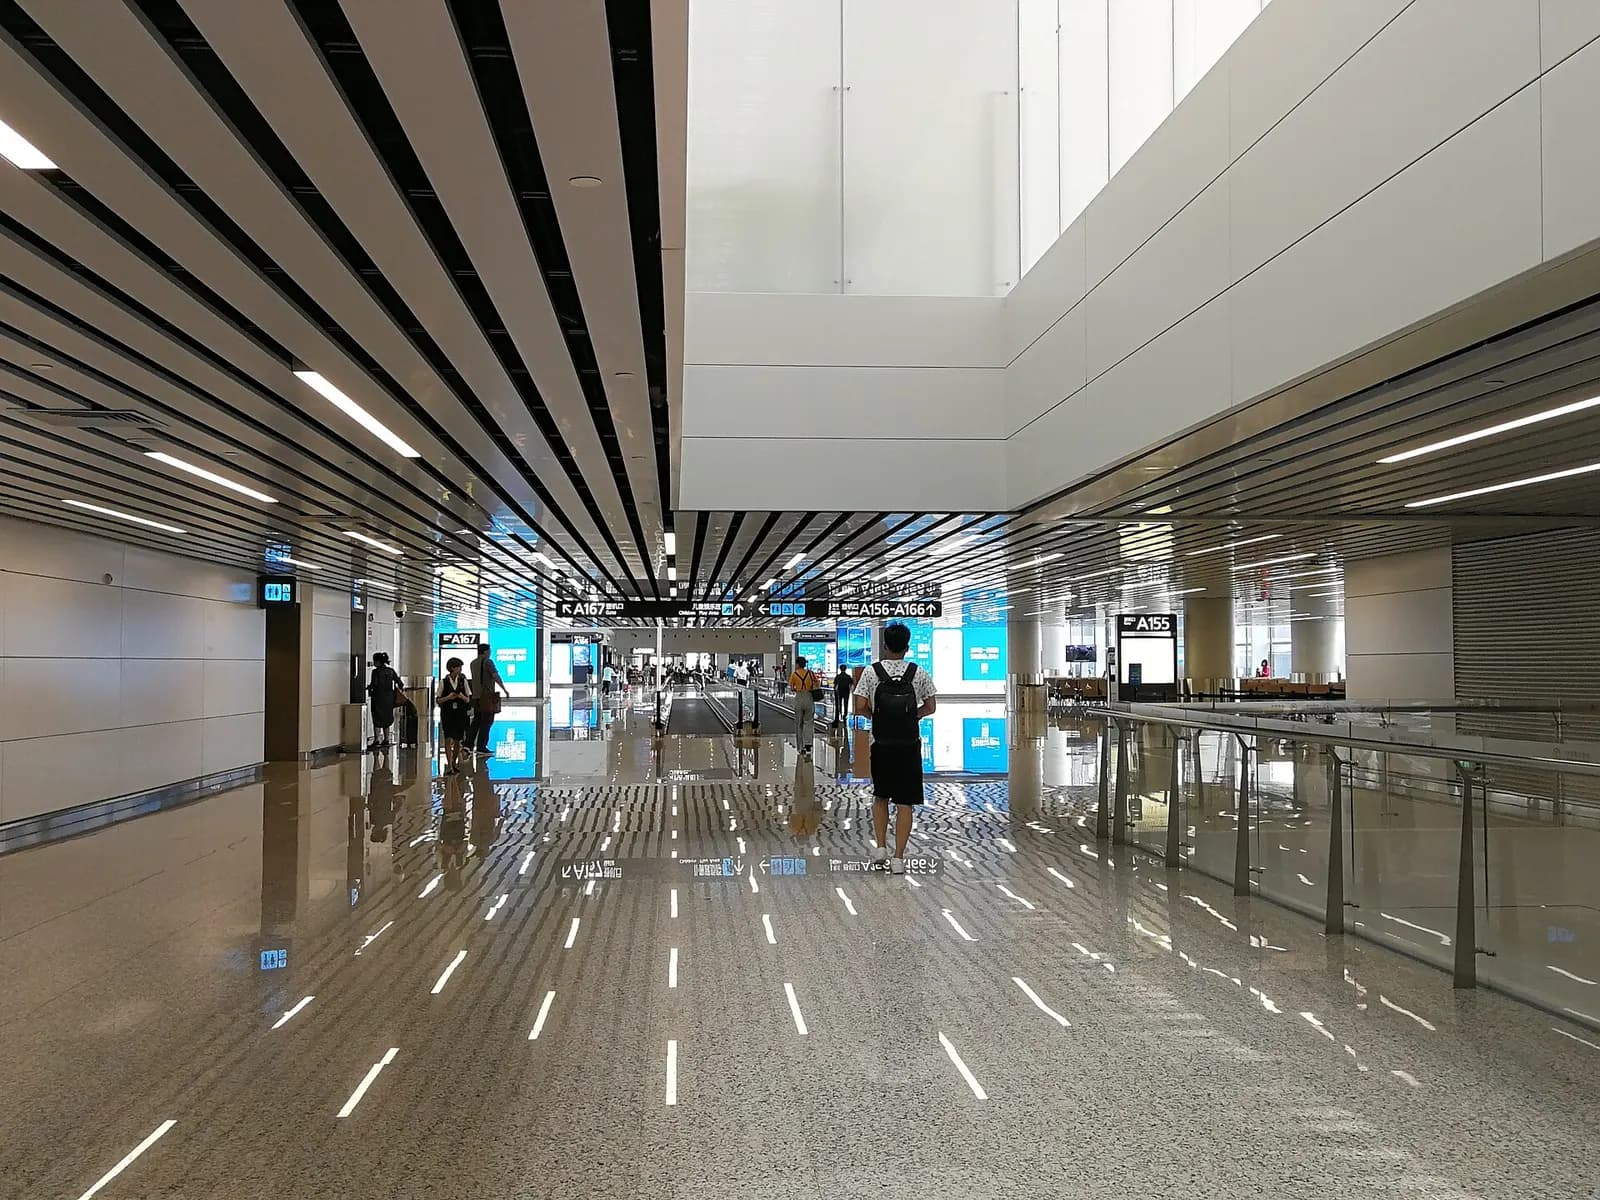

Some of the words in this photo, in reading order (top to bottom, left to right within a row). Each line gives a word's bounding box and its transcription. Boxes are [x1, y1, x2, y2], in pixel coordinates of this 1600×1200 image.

[573, 602, 605, 616] A167
[860, 602, 925, 616] A156-A166
[1136, 616, 1170, 631] A155
[451, 634, 476, 644] A167
